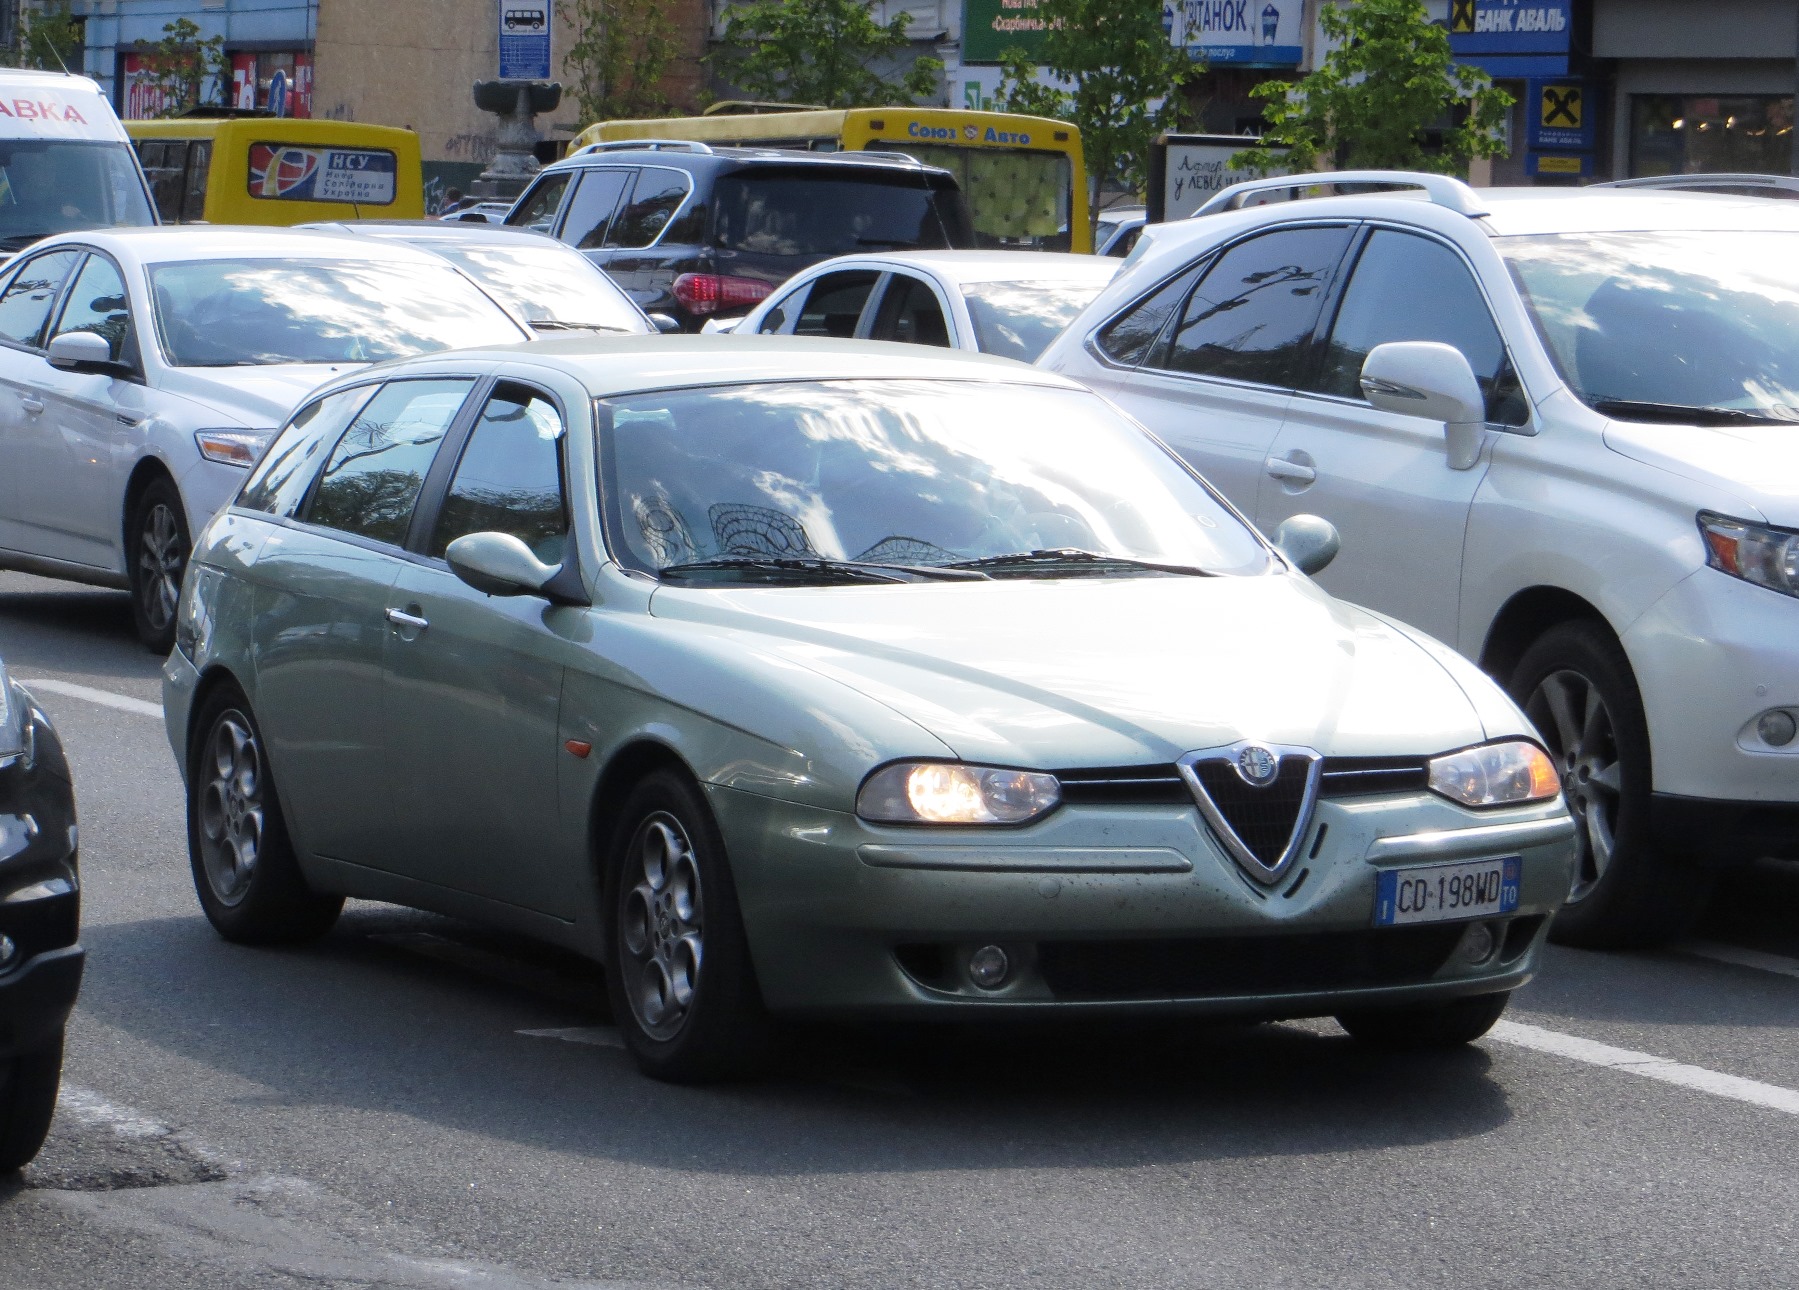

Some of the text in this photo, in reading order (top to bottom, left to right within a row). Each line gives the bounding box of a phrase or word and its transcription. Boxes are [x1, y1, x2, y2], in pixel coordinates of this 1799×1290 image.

[1474, 8, 1566, 32] БАНК АВАЛЬ
[332, 154, 369, 169] НСУ
